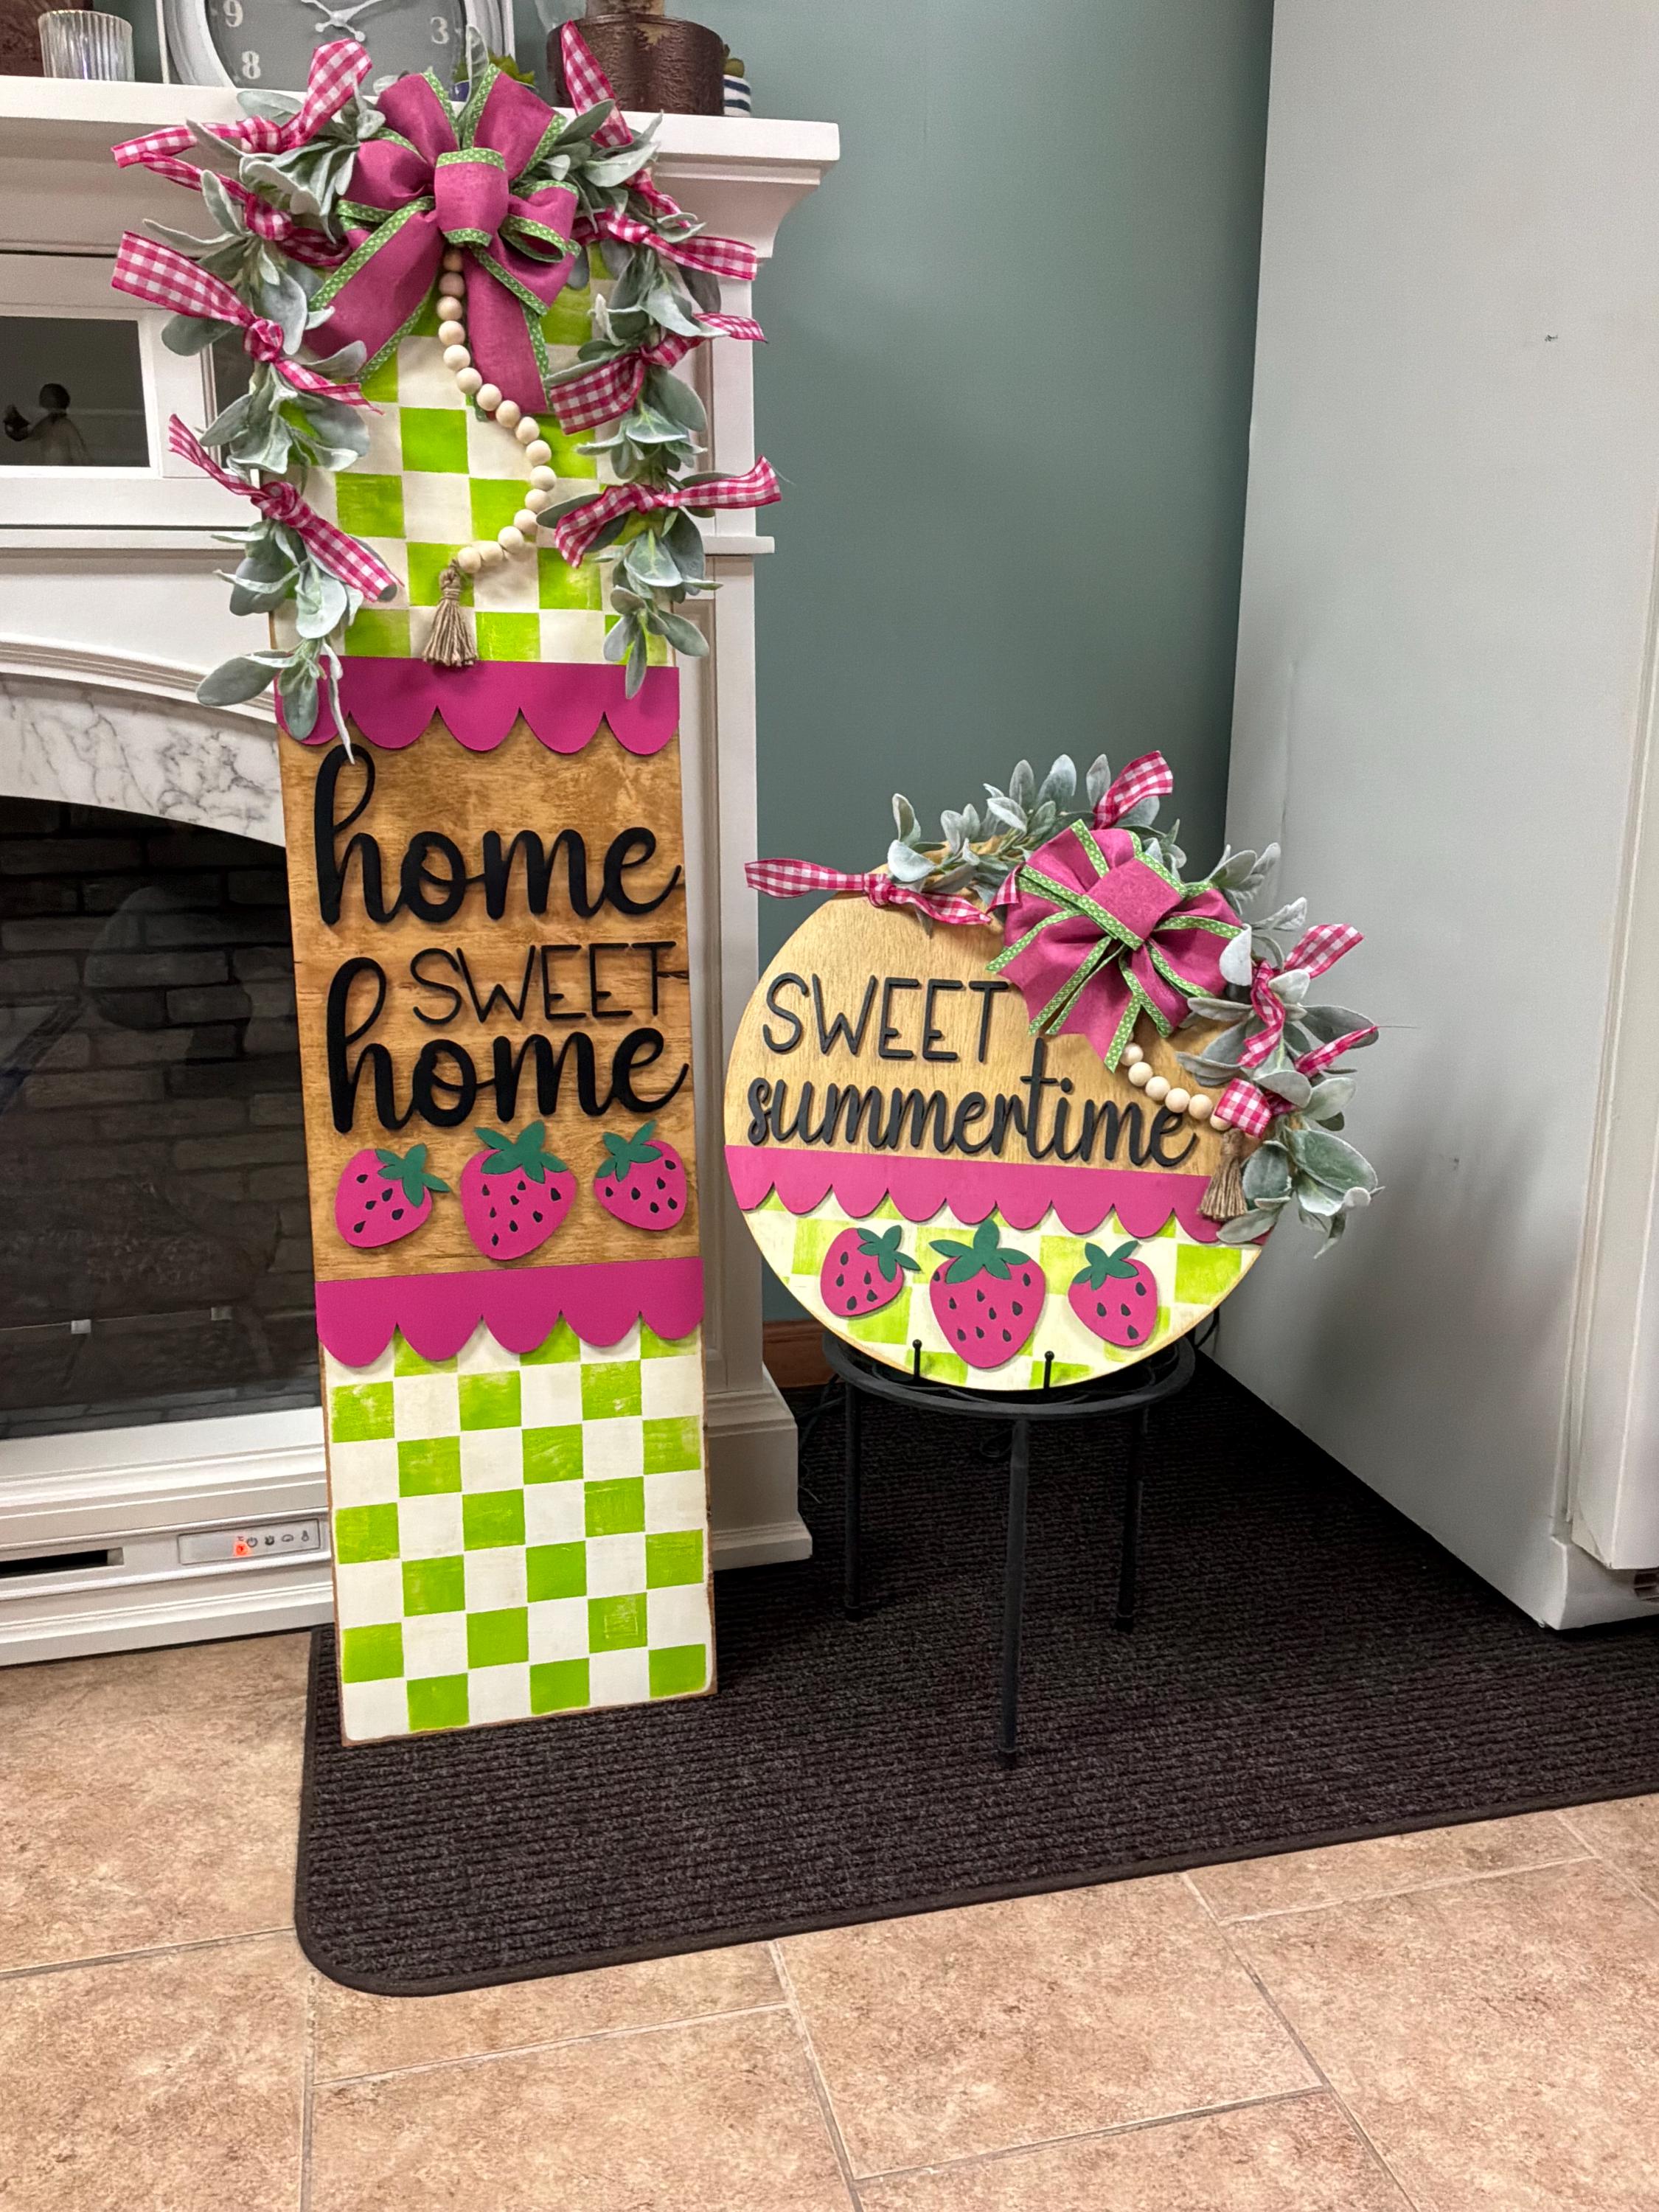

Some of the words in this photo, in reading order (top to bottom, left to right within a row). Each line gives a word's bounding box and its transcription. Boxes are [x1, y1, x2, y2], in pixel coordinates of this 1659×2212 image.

[223, 0, 243, 27] 9
[431, 16, 450, 44] 3
[242, 51, 261, 80] 8
[314, 743, 681, 925] home
[411, 941, 676, 1024] SWEET
[762, 973, 1009, 1062] SWEET
[327, 957, 689, 1133] home
[747, 1037, 1197, 1166] summertime
